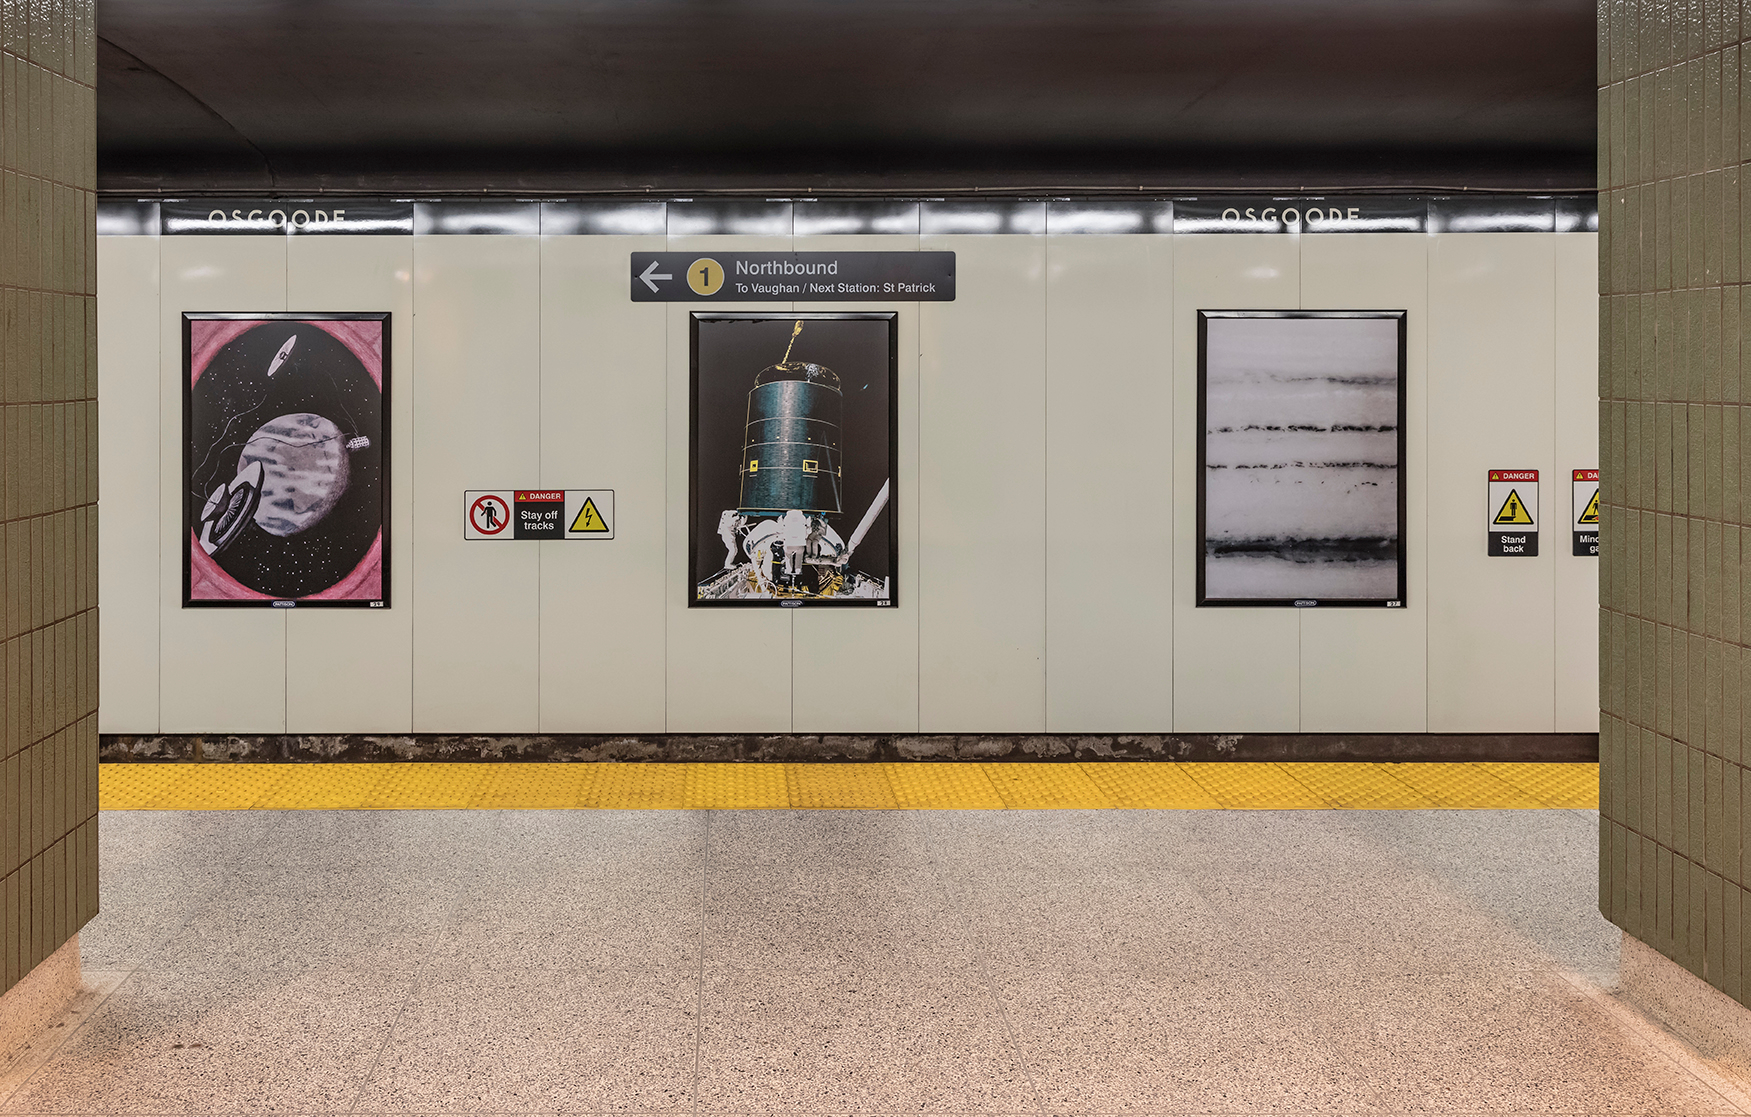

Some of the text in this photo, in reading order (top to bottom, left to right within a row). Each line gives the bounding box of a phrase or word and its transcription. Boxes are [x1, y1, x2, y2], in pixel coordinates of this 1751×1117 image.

[208, 209, 346, 228] OSGOODE
[1221, 207, 1360, 226] OSGOODE
[736, 260, 838, 275] Northbound
[699, 266, 709, 287] 1
[735, 282, 936, 296] To Vaughan / Next Station: St Patrick
[1503, 472, 1535, 480] DANGER
[520, 510, 558, 522] Stay off
[524, 521, 555, 530] tracks
[1501, 535, 1526, 544] Stand
[1503, 544, 1525, 553] back
